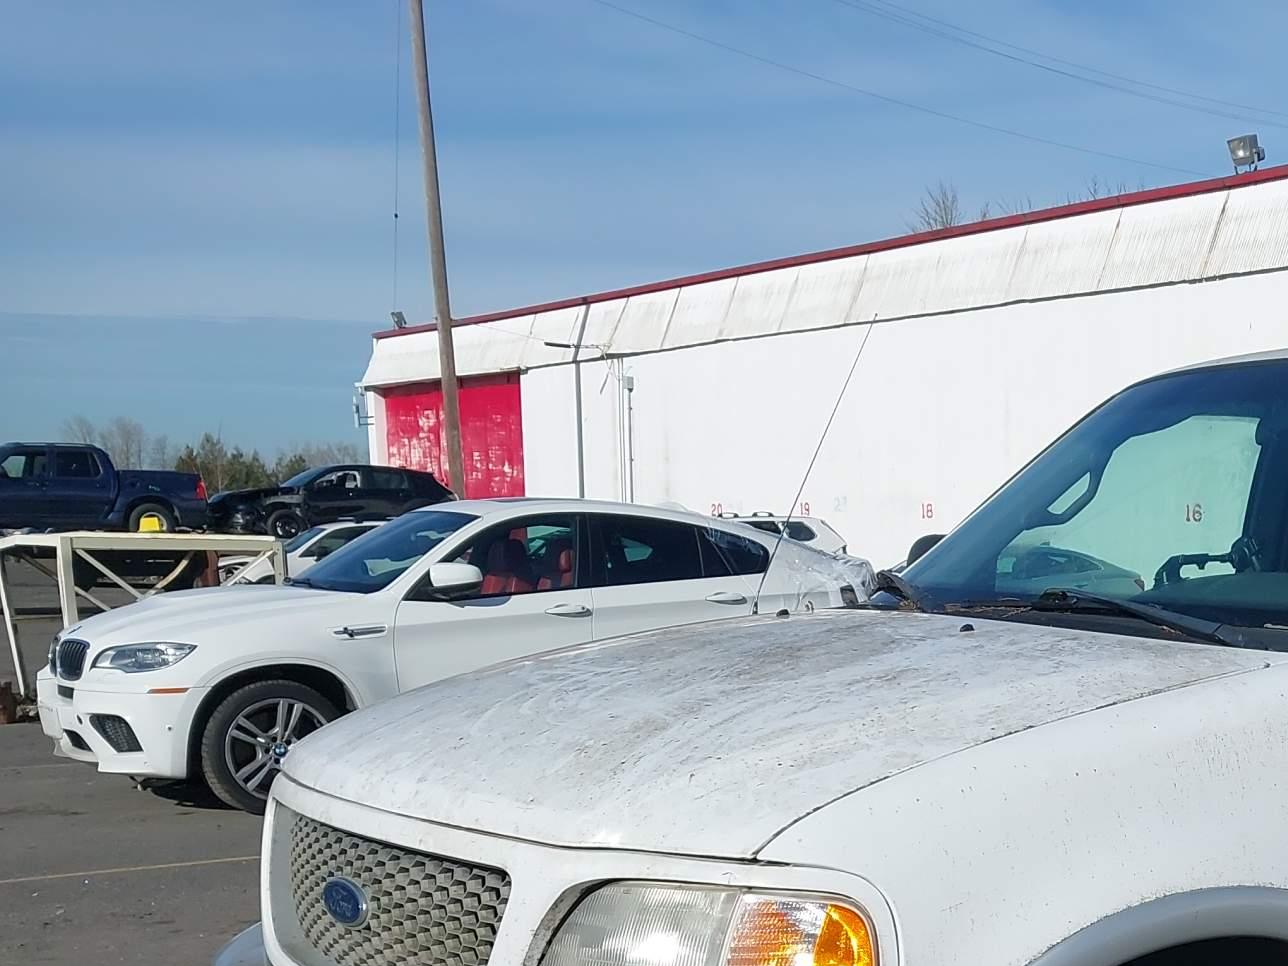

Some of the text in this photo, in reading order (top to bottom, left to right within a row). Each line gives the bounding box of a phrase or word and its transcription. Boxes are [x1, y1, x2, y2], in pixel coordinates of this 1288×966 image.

[711, 504, 723, 517] 20
[799, 502, 811, 516] 19
[921, 503, 934, 519] 18
[1185, 504, 1203, 522] 16
